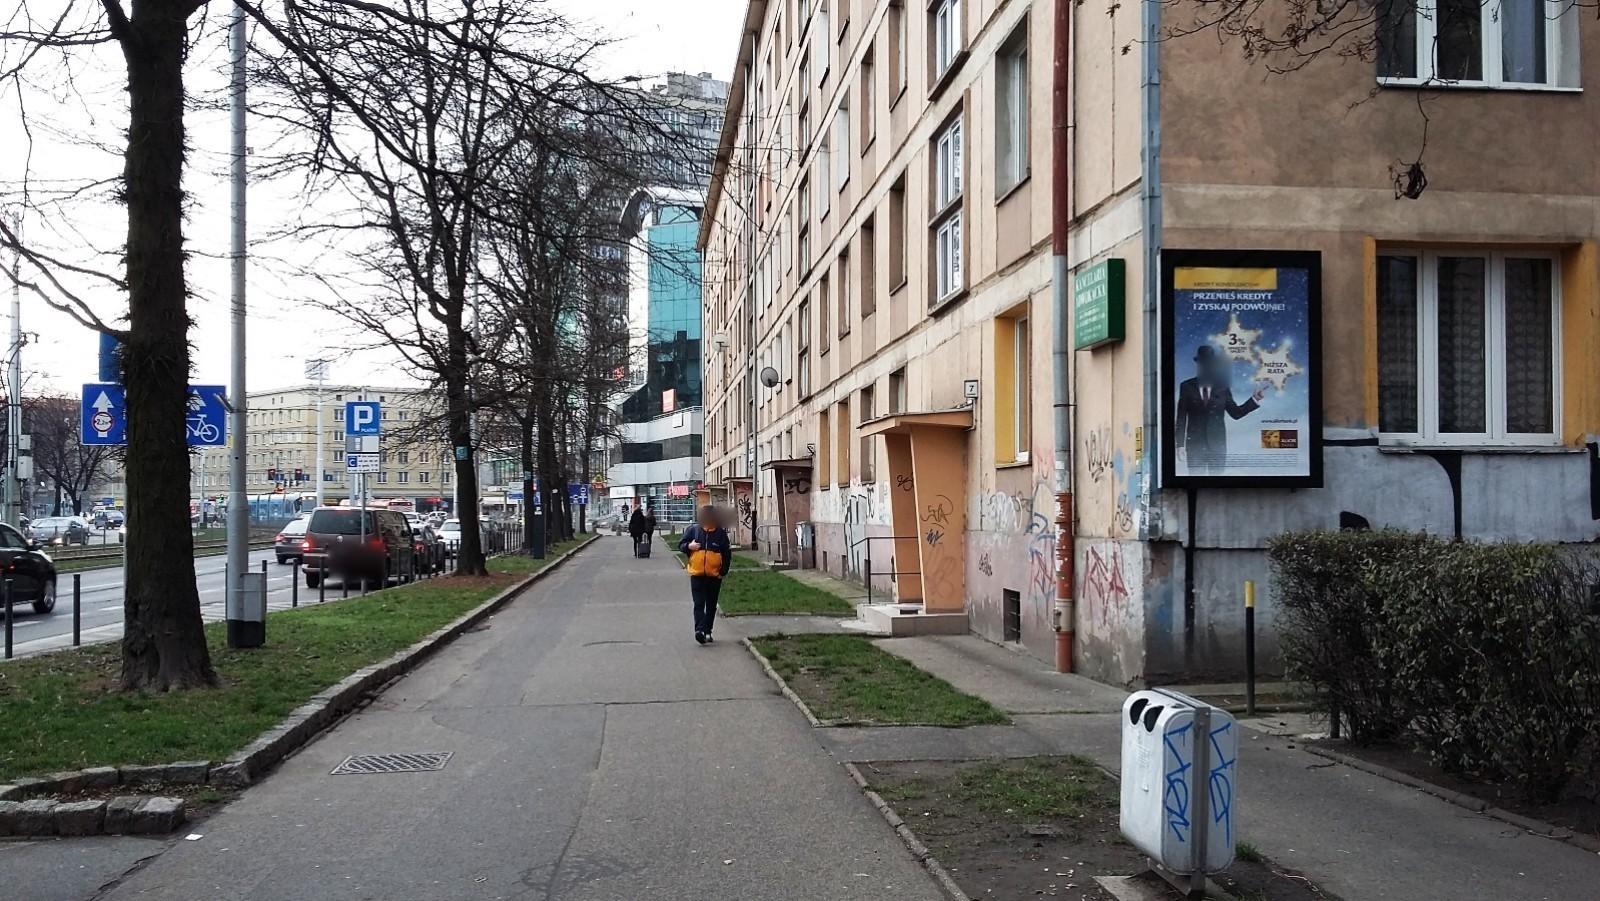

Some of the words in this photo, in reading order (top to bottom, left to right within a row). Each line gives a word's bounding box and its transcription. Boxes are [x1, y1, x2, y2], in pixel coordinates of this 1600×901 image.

[1193, 290, 1236, 300] PRZENIEŚ
[1197, 303, 1230, 312] ZYSKAJ
[1231, 301, 1286, 312] PODWÓJNIE!
[353, 405, 373, 432] P
